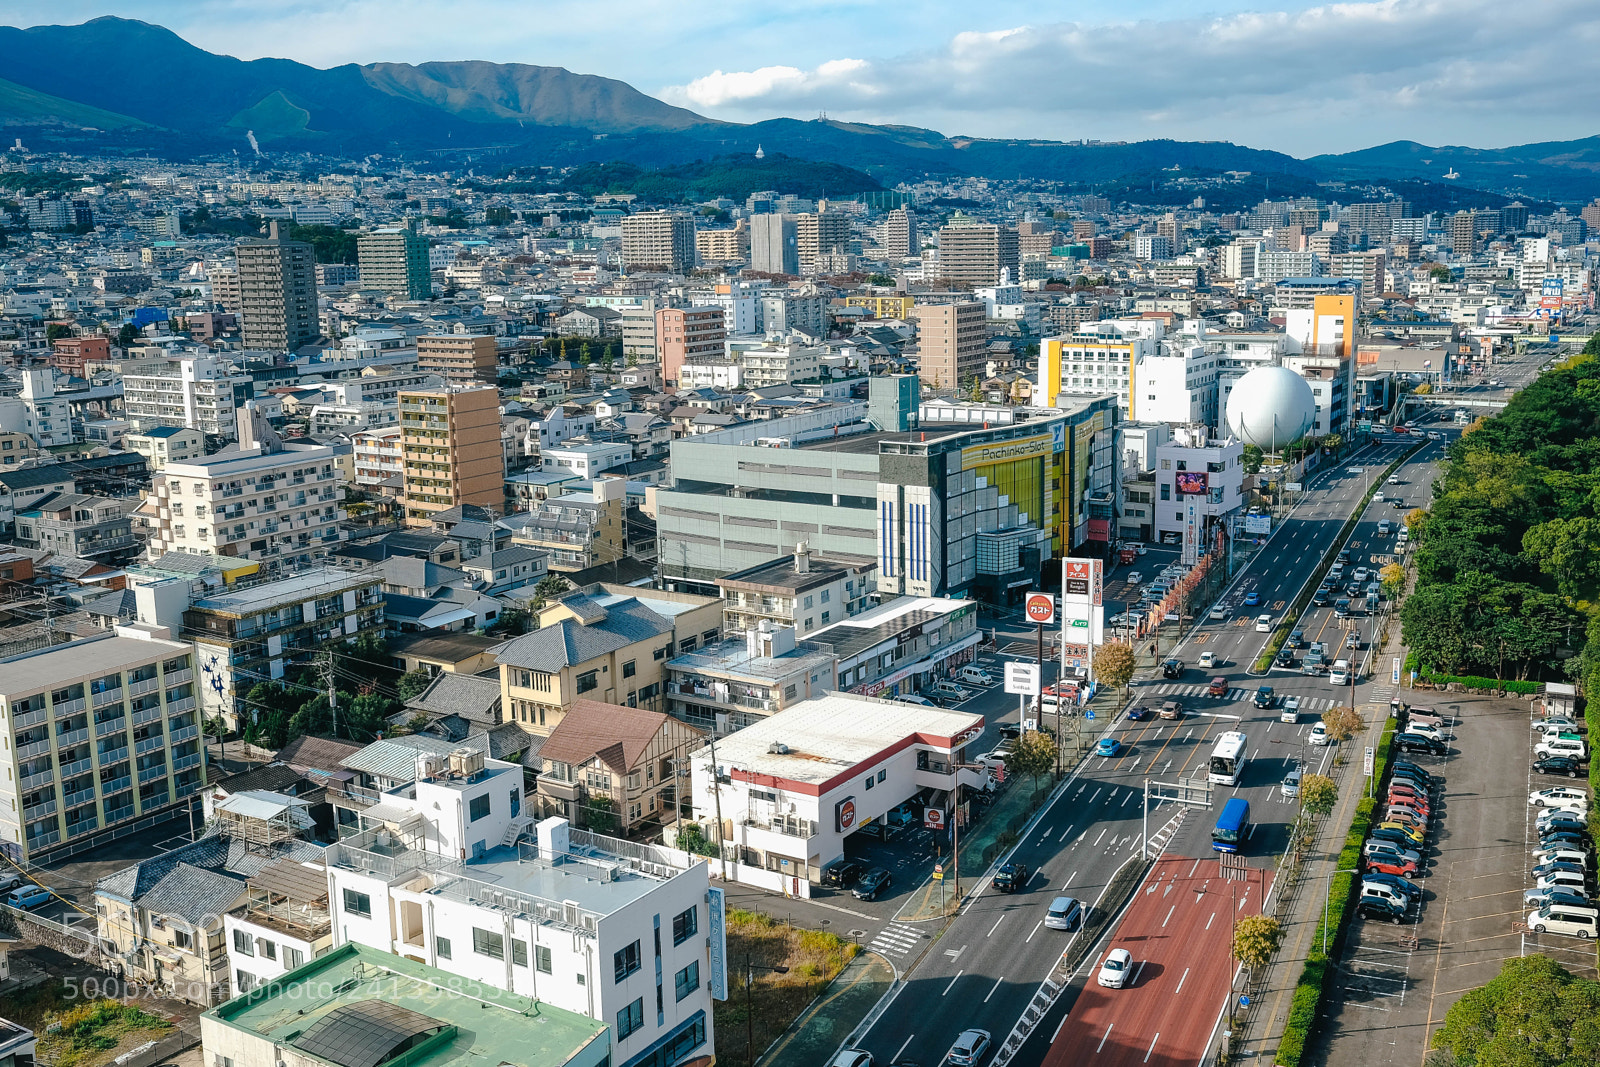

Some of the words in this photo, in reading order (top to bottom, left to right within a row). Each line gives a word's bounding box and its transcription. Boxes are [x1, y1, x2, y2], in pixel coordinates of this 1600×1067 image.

[1544, 287, 1560, 296] 青山
[1030, 606, 1050, 615] ガスト
